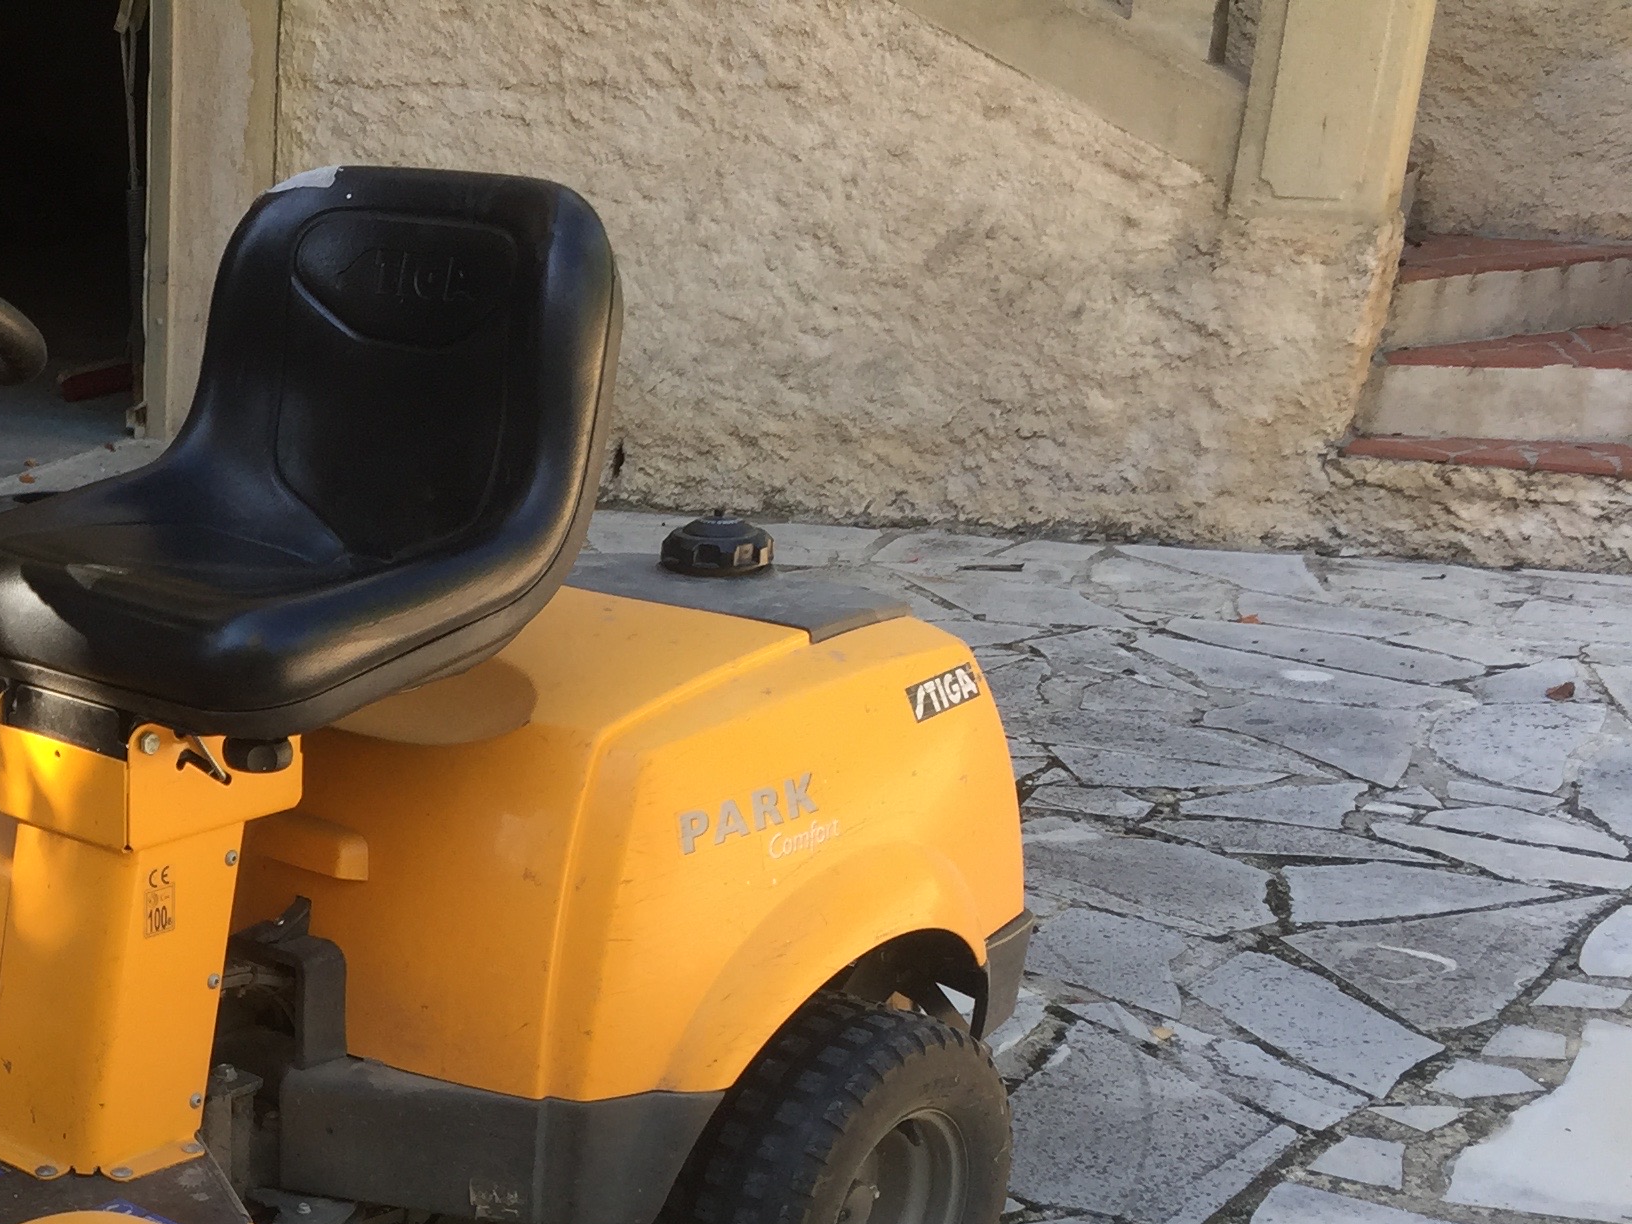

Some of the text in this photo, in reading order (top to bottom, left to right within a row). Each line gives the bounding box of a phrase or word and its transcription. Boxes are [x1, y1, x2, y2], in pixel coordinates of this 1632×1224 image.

[914, 667, 979, 720] STIGA
[678, 772, 820, 855] PARK
[768, 818, 841, 860] Comfort
[148, 865, 170, 888] CE
